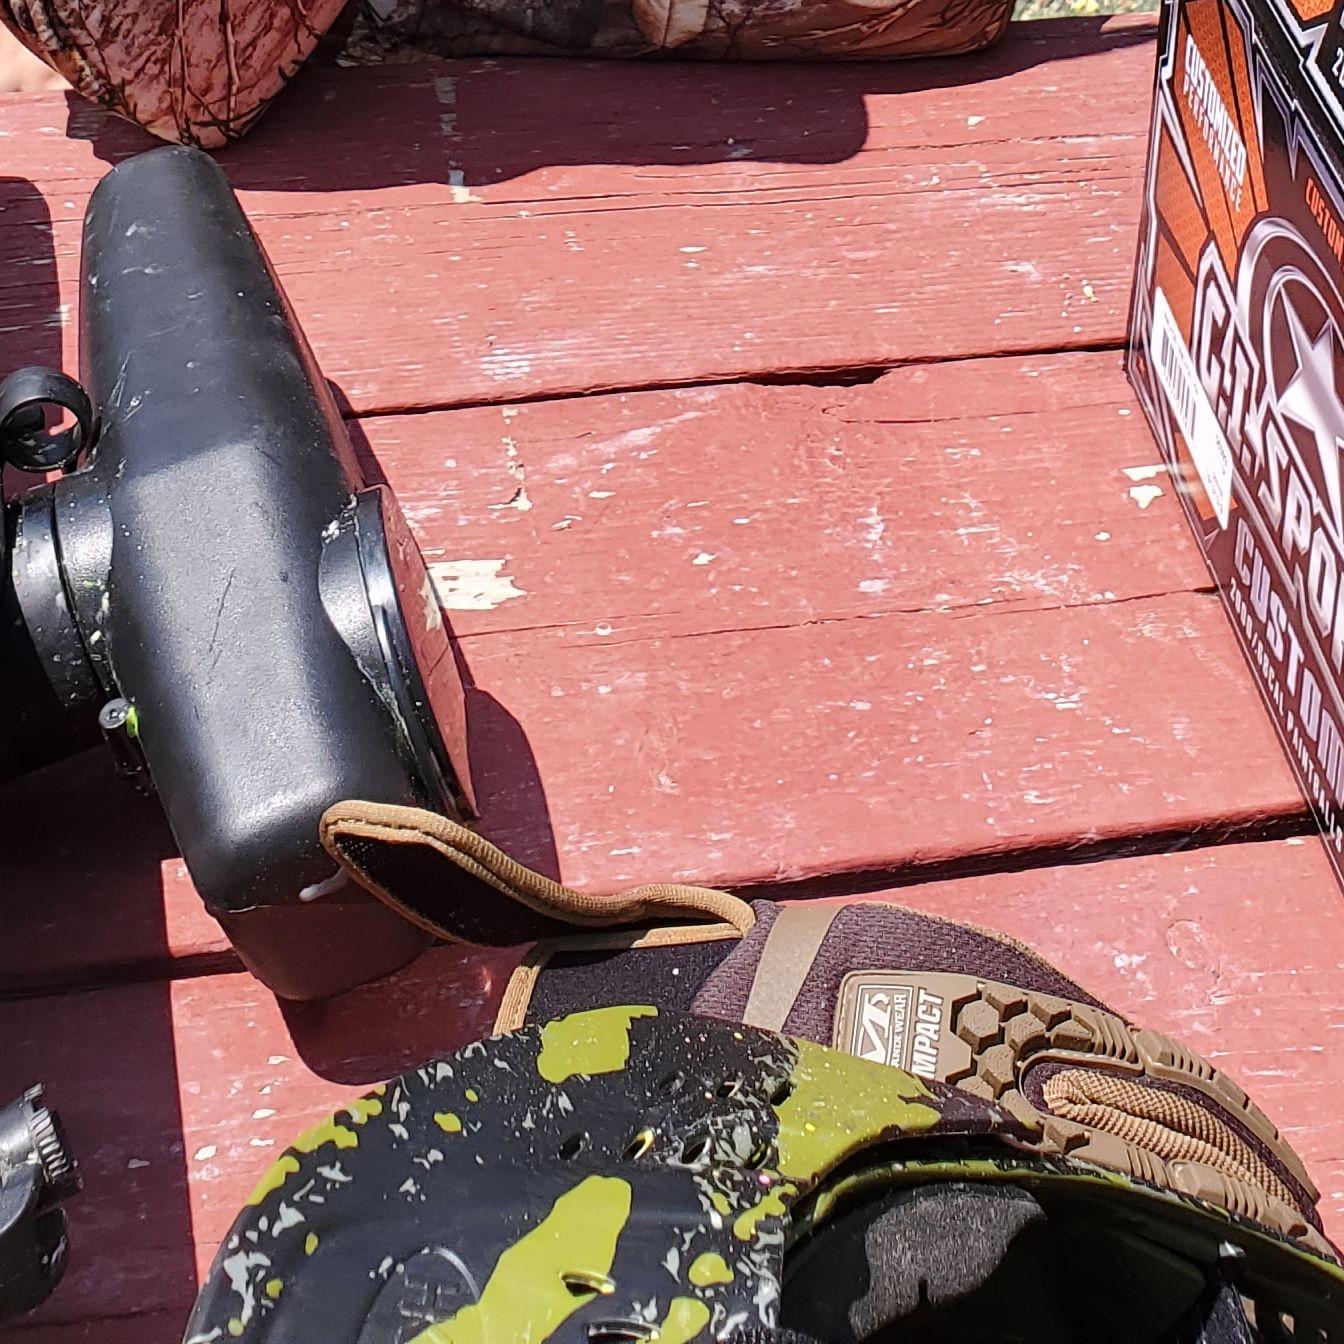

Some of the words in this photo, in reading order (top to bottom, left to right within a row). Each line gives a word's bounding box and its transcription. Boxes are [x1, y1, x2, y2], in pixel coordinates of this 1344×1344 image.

[1183, 74, 1243, 213] PERFORMANCE
[1185, 34, 1247, 187] CUSTOMIZED
[1306, 177, 1344, 262] CUSTOM
[1287, 713, 1343, 854] PAINTBALLS
[893, 994, 907, 1035] WEAR
[912, 988, 944, 1080] MPACT
